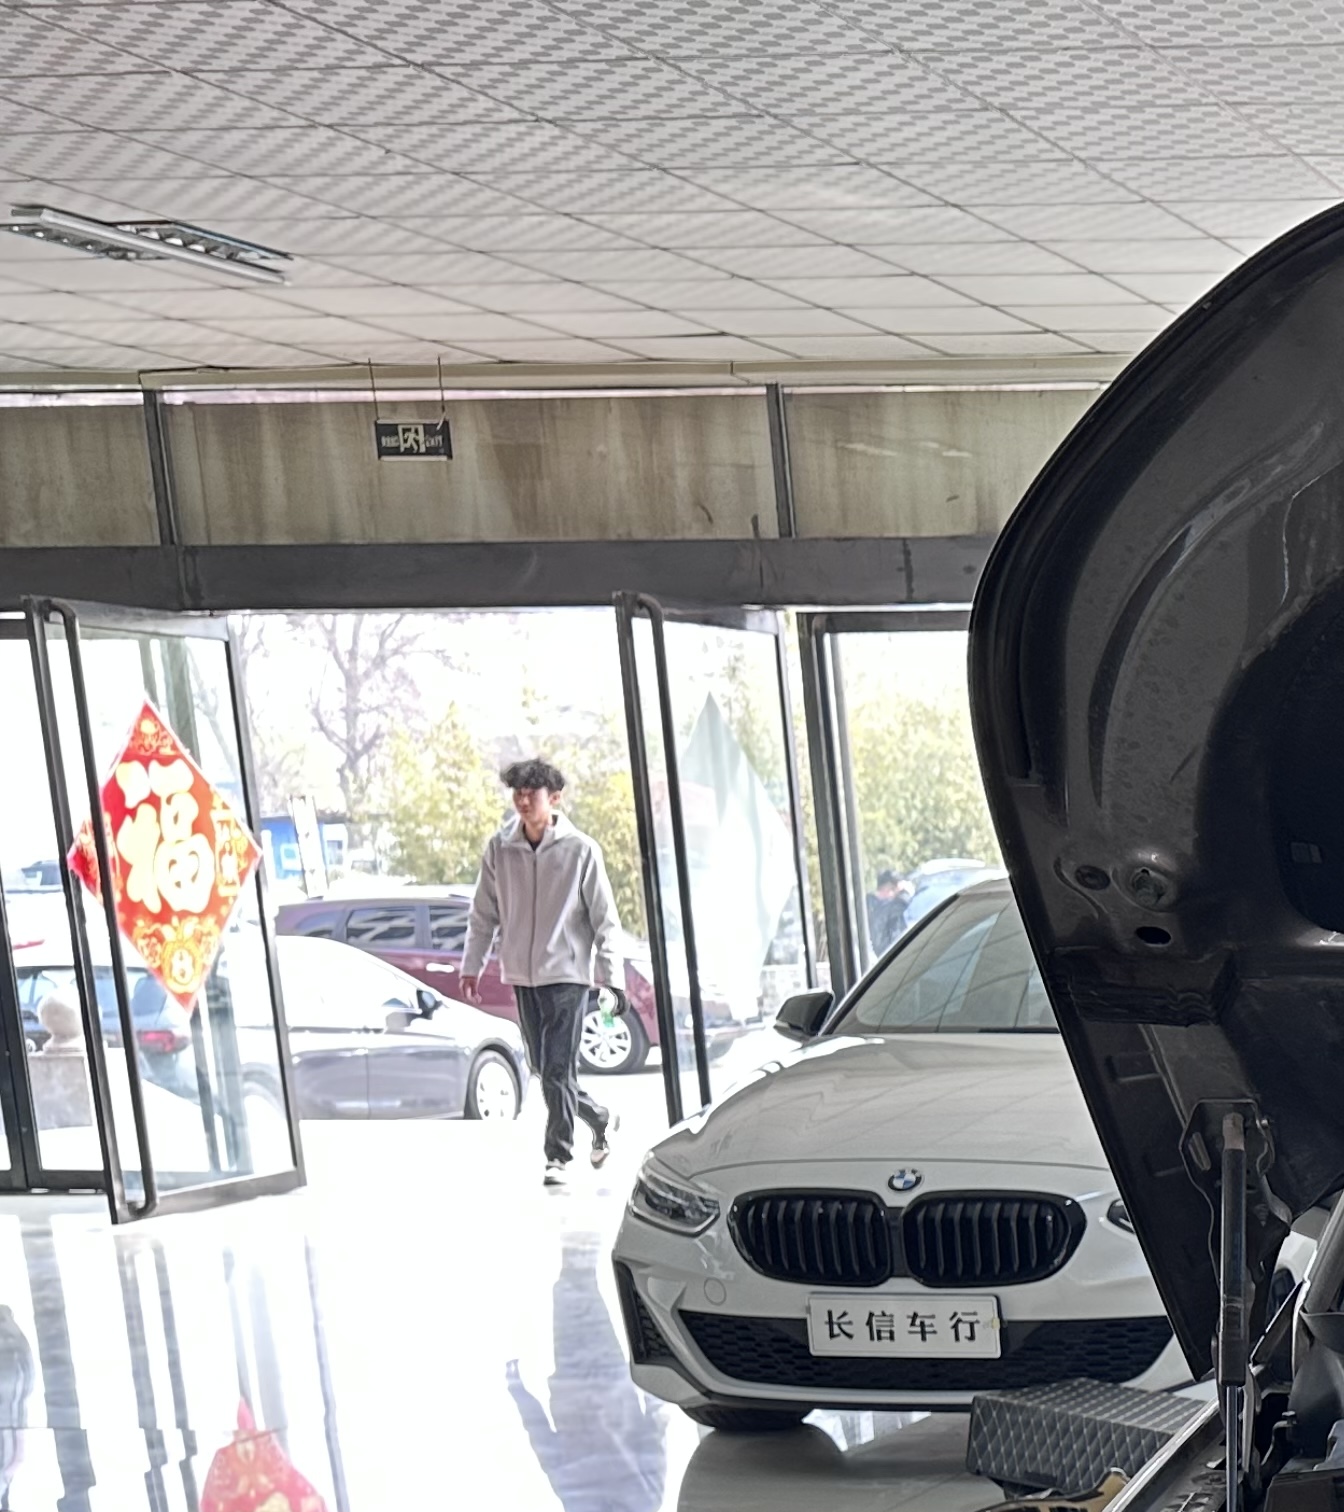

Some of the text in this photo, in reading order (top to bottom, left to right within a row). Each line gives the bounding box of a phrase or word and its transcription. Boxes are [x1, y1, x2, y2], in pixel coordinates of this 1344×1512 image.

[115, 758, 215, 914] 福
[825, 1309, 981, 1342] 长信车行
